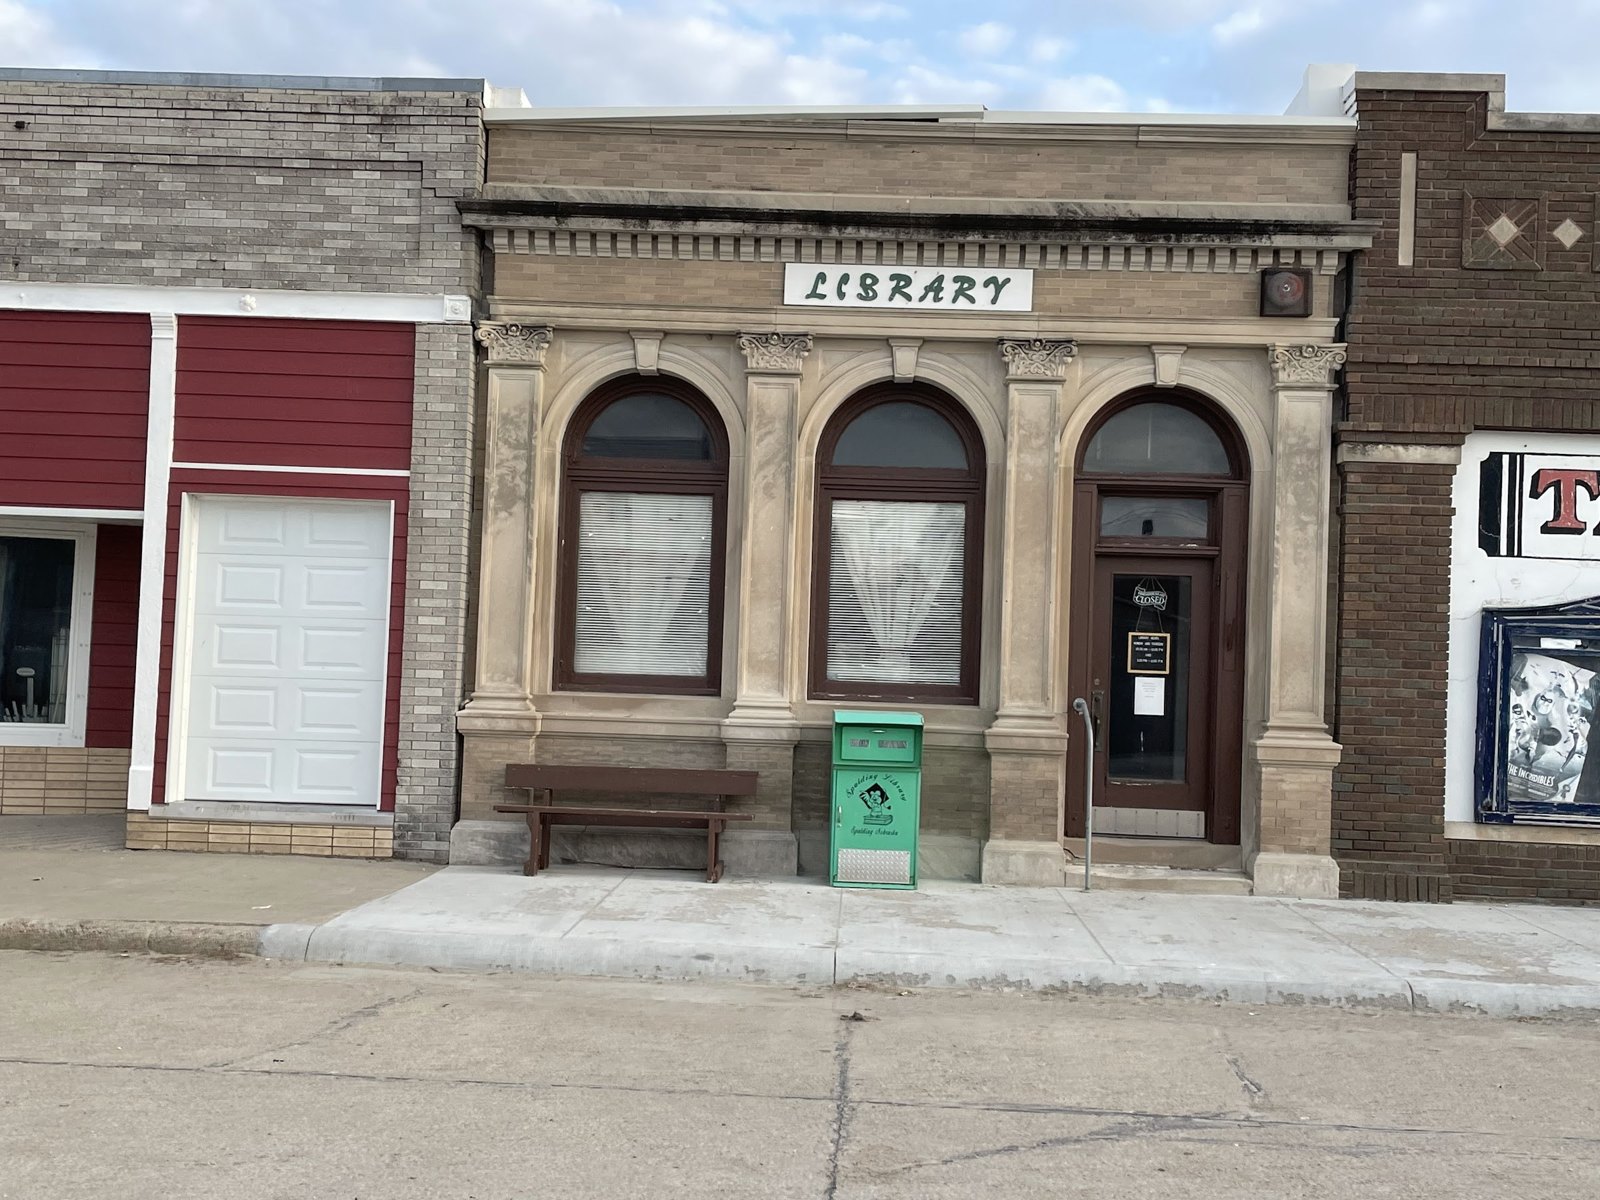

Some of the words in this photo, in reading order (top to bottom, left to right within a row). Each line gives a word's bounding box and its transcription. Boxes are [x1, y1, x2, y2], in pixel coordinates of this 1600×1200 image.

[805, 271, 1012, 305] LIBRARY
[1529, 468, 1600, 536] T
[1135, 594, 1165, 605] CLOSED
[1508, 762, 1518, 776] THE
[1518, 767, 1555, 786] INCREDIBLES
